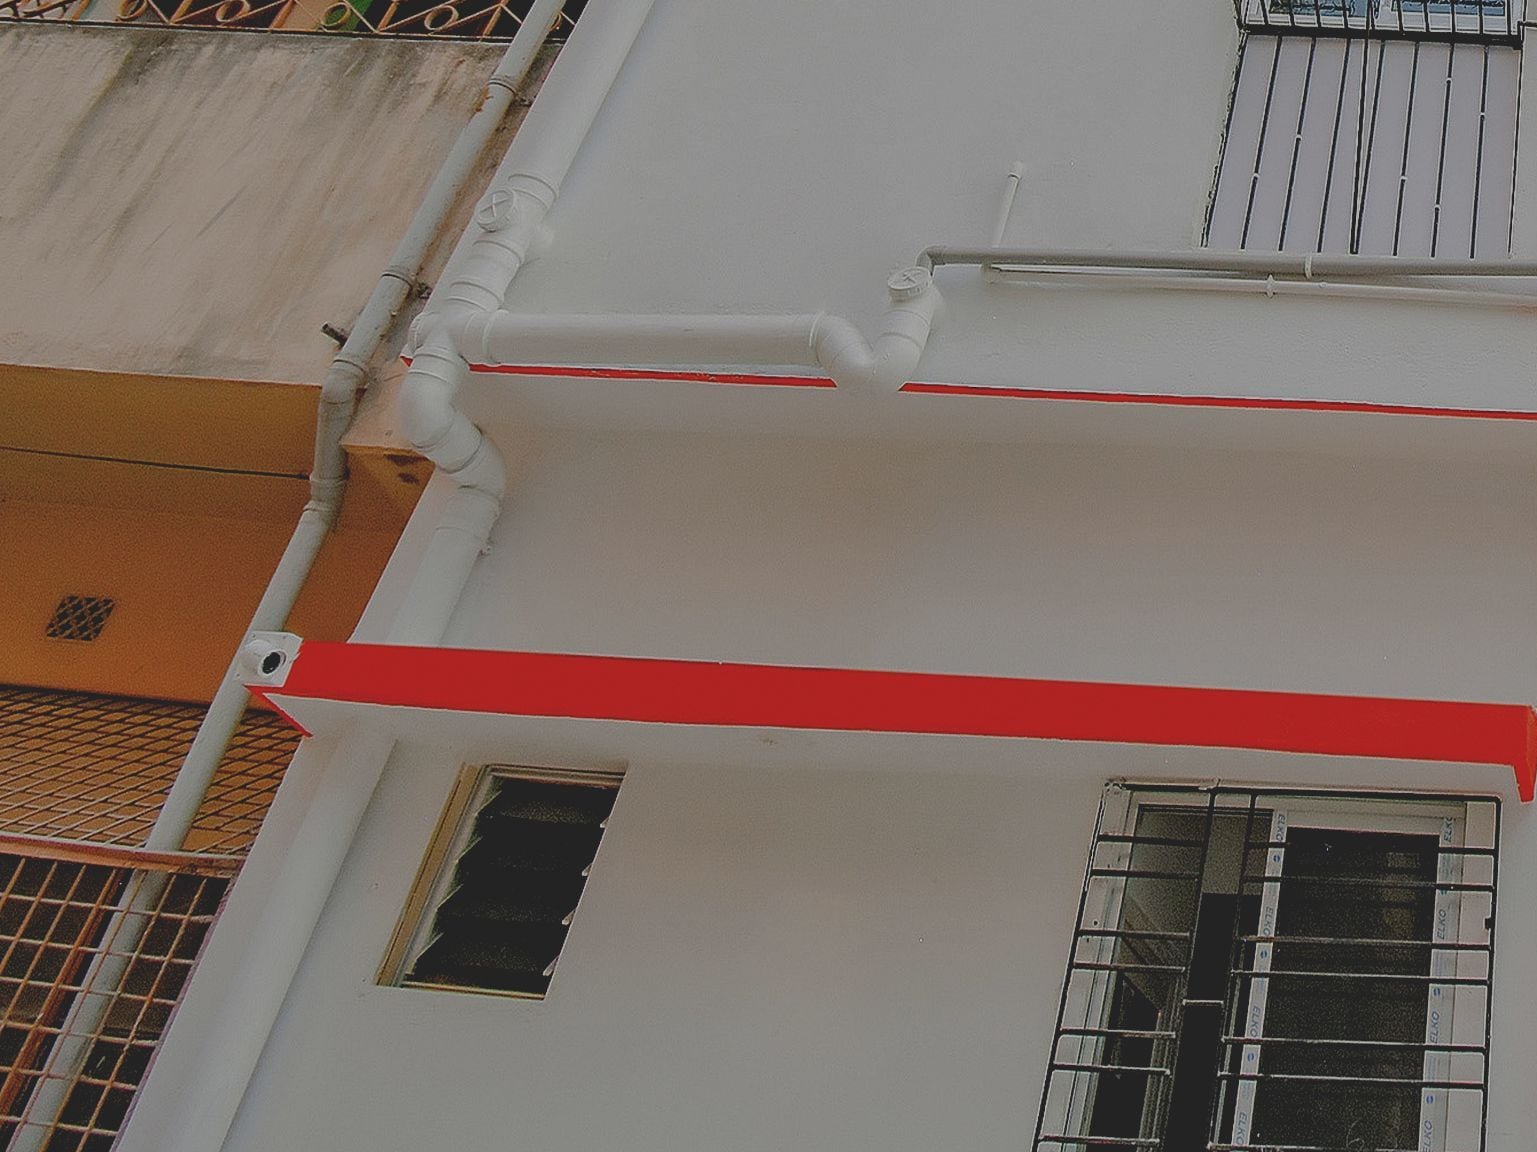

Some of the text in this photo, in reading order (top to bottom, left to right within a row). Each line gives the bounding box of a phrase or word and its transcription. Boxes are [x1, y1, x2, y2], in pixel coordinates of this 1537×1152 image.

[1436, 909, 1447, 940] ELKO
[1249, 1005, 1261, 1038] ELKO
[1429, 1011, 1440, 1044] ELKO
[1235, 1111, 1248, 1146] ELKO
